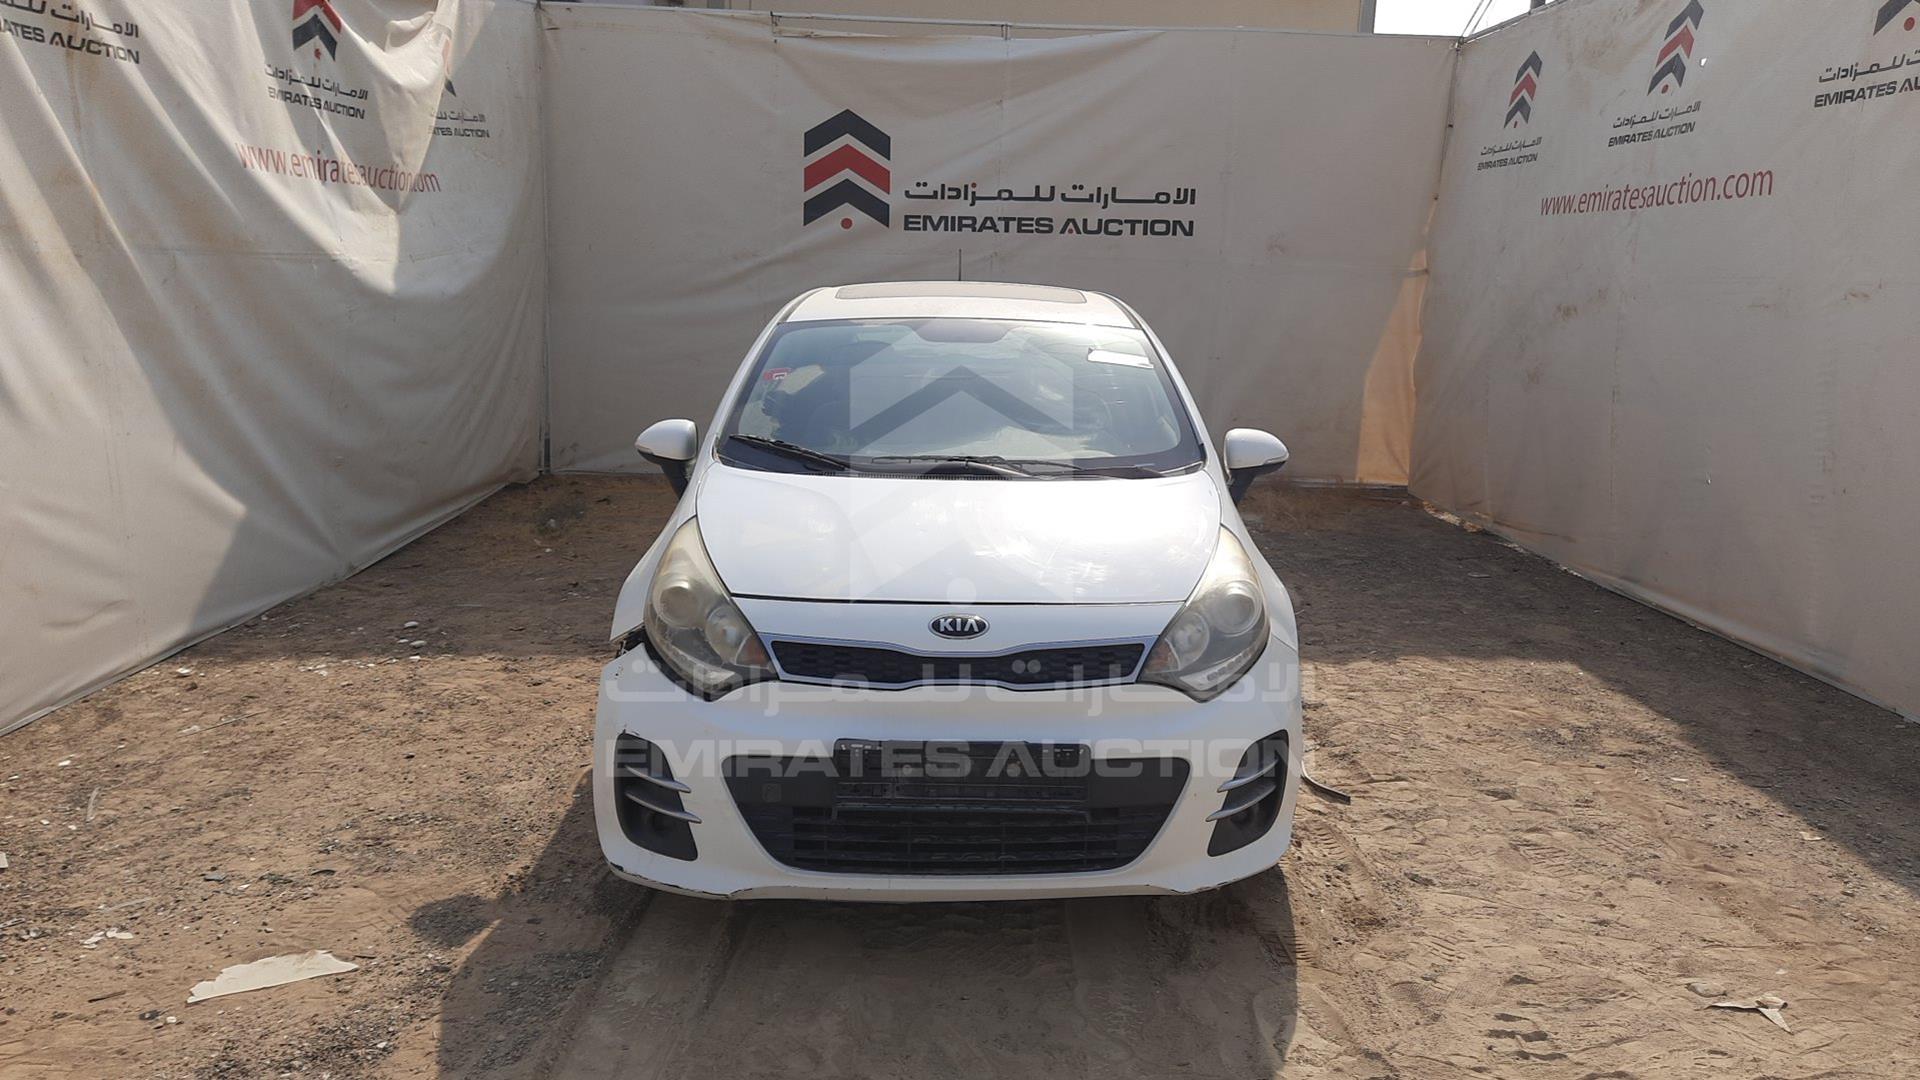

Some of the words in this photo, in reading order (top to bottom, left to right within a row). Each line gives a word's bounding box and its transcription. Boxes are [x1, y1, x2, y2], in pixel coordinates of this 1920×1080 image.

[48, 31, 140, 64] AUCTION
[1813, 80, 1898, 108] EMIRATES
[323, 100, 366, 119] AUCTION
[454, 127, 490, 138] AUCTION
[1608, 130, 1654, 147] EMIRATES
[1653, 121, 1696, 140] AUCTION
[1477, 157, 1508, 171] EMIRATES
[1508, 152, 1539, 165] AUCTION
[1540, 168, 1774, 216] www.emiratesauction.com
[903, 214, 1055, 235] EMIRATES
[1059, 217, 1194, 237] AUCTION
[939, 618, 980, 633] KIA
